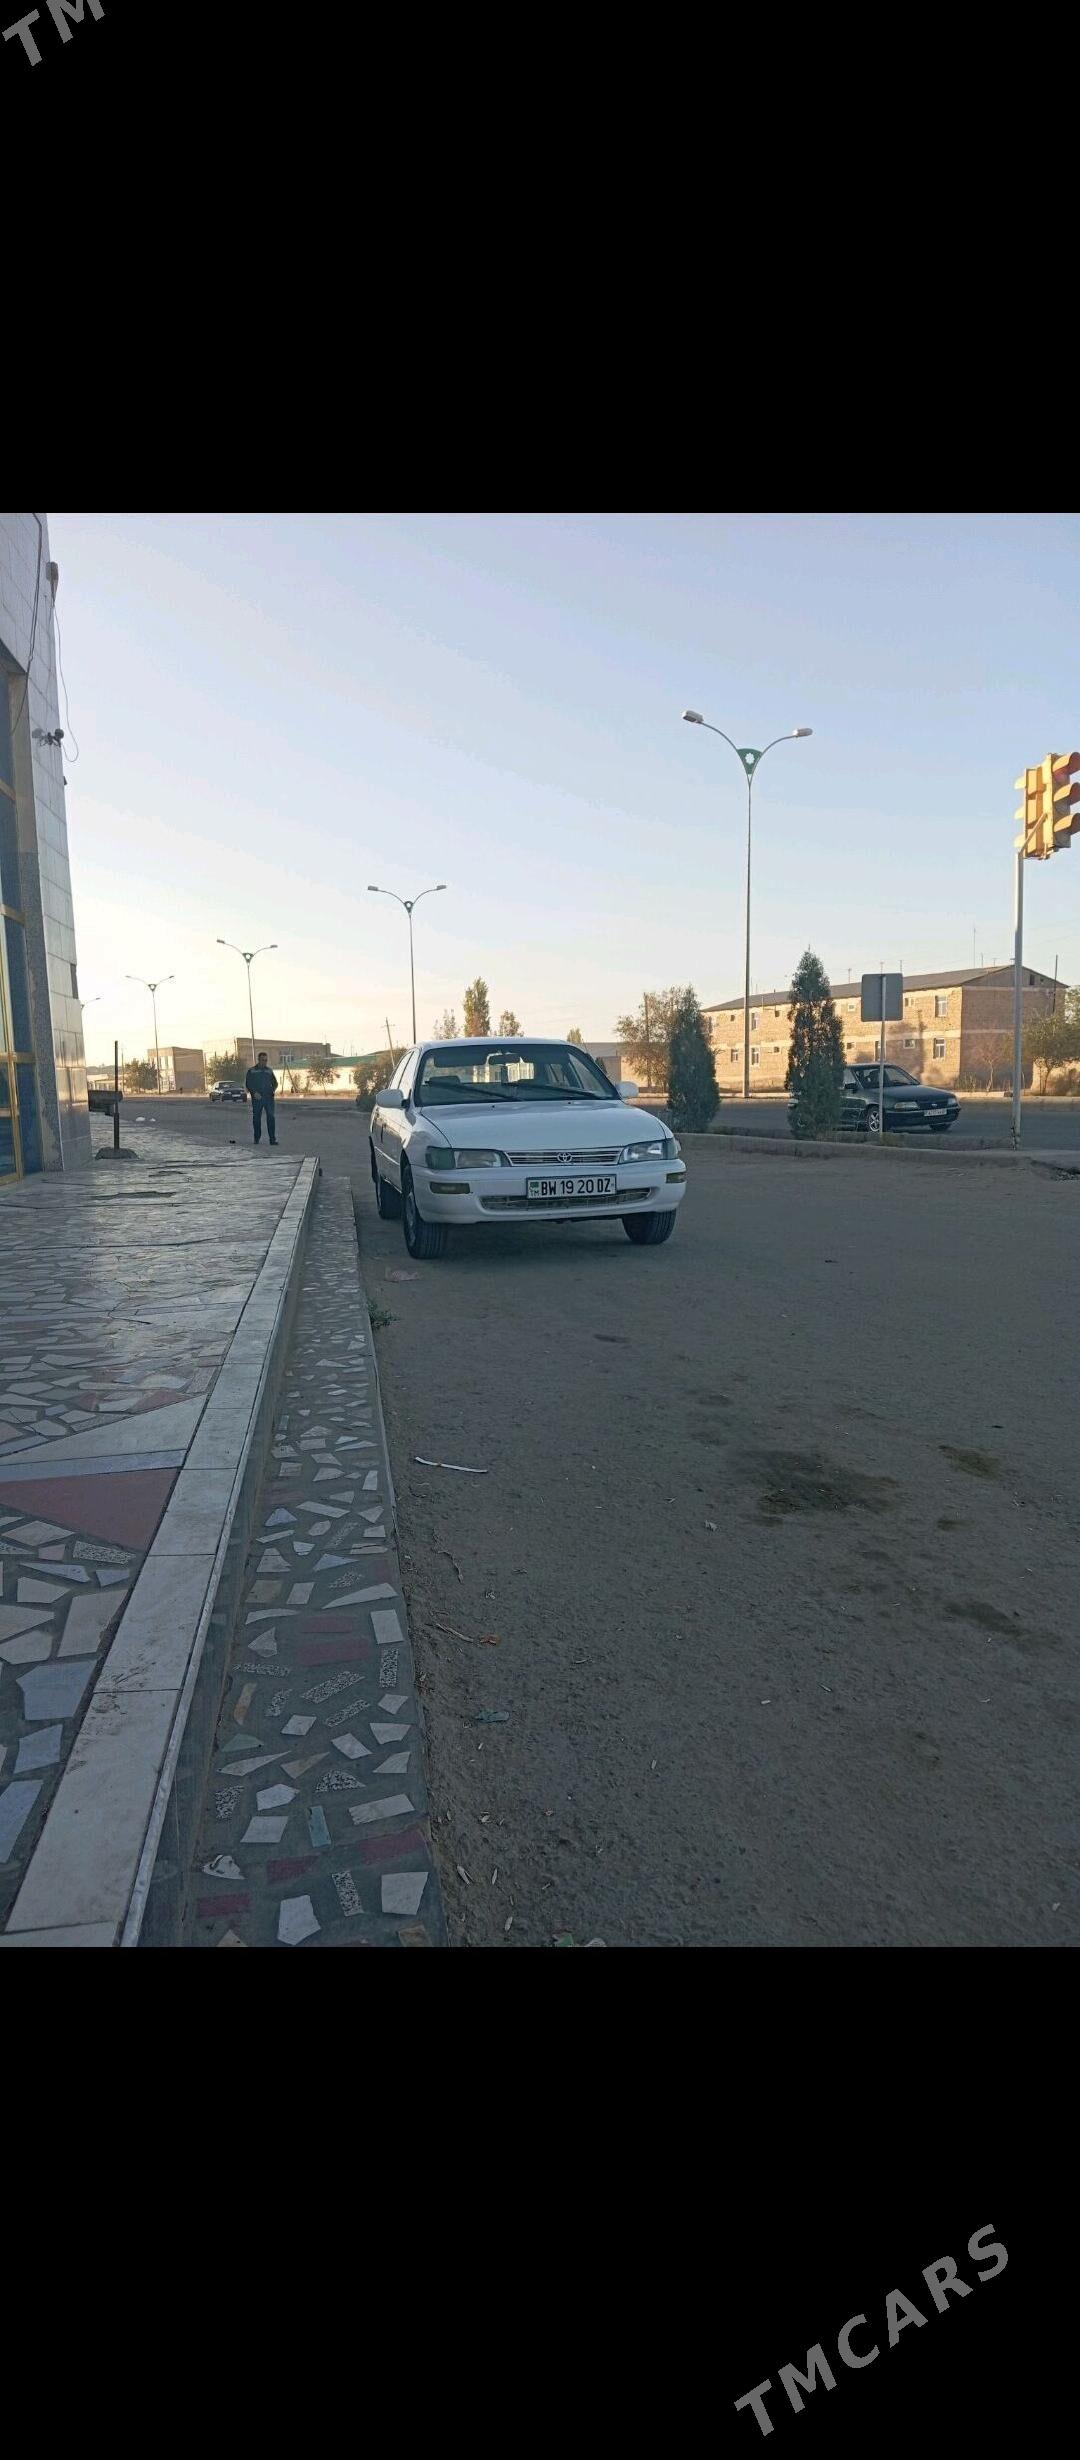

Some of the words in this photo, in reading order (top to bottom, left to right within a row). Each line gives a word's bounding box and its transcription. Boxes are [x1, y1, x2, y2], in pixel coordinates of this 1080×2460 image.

[541, 1181, 557, 1196] BW
[561, 1180, 574, 1195] 19
[578, 1179, 594, 1194] 20
[597, 1178, 611, 1193] DZ
